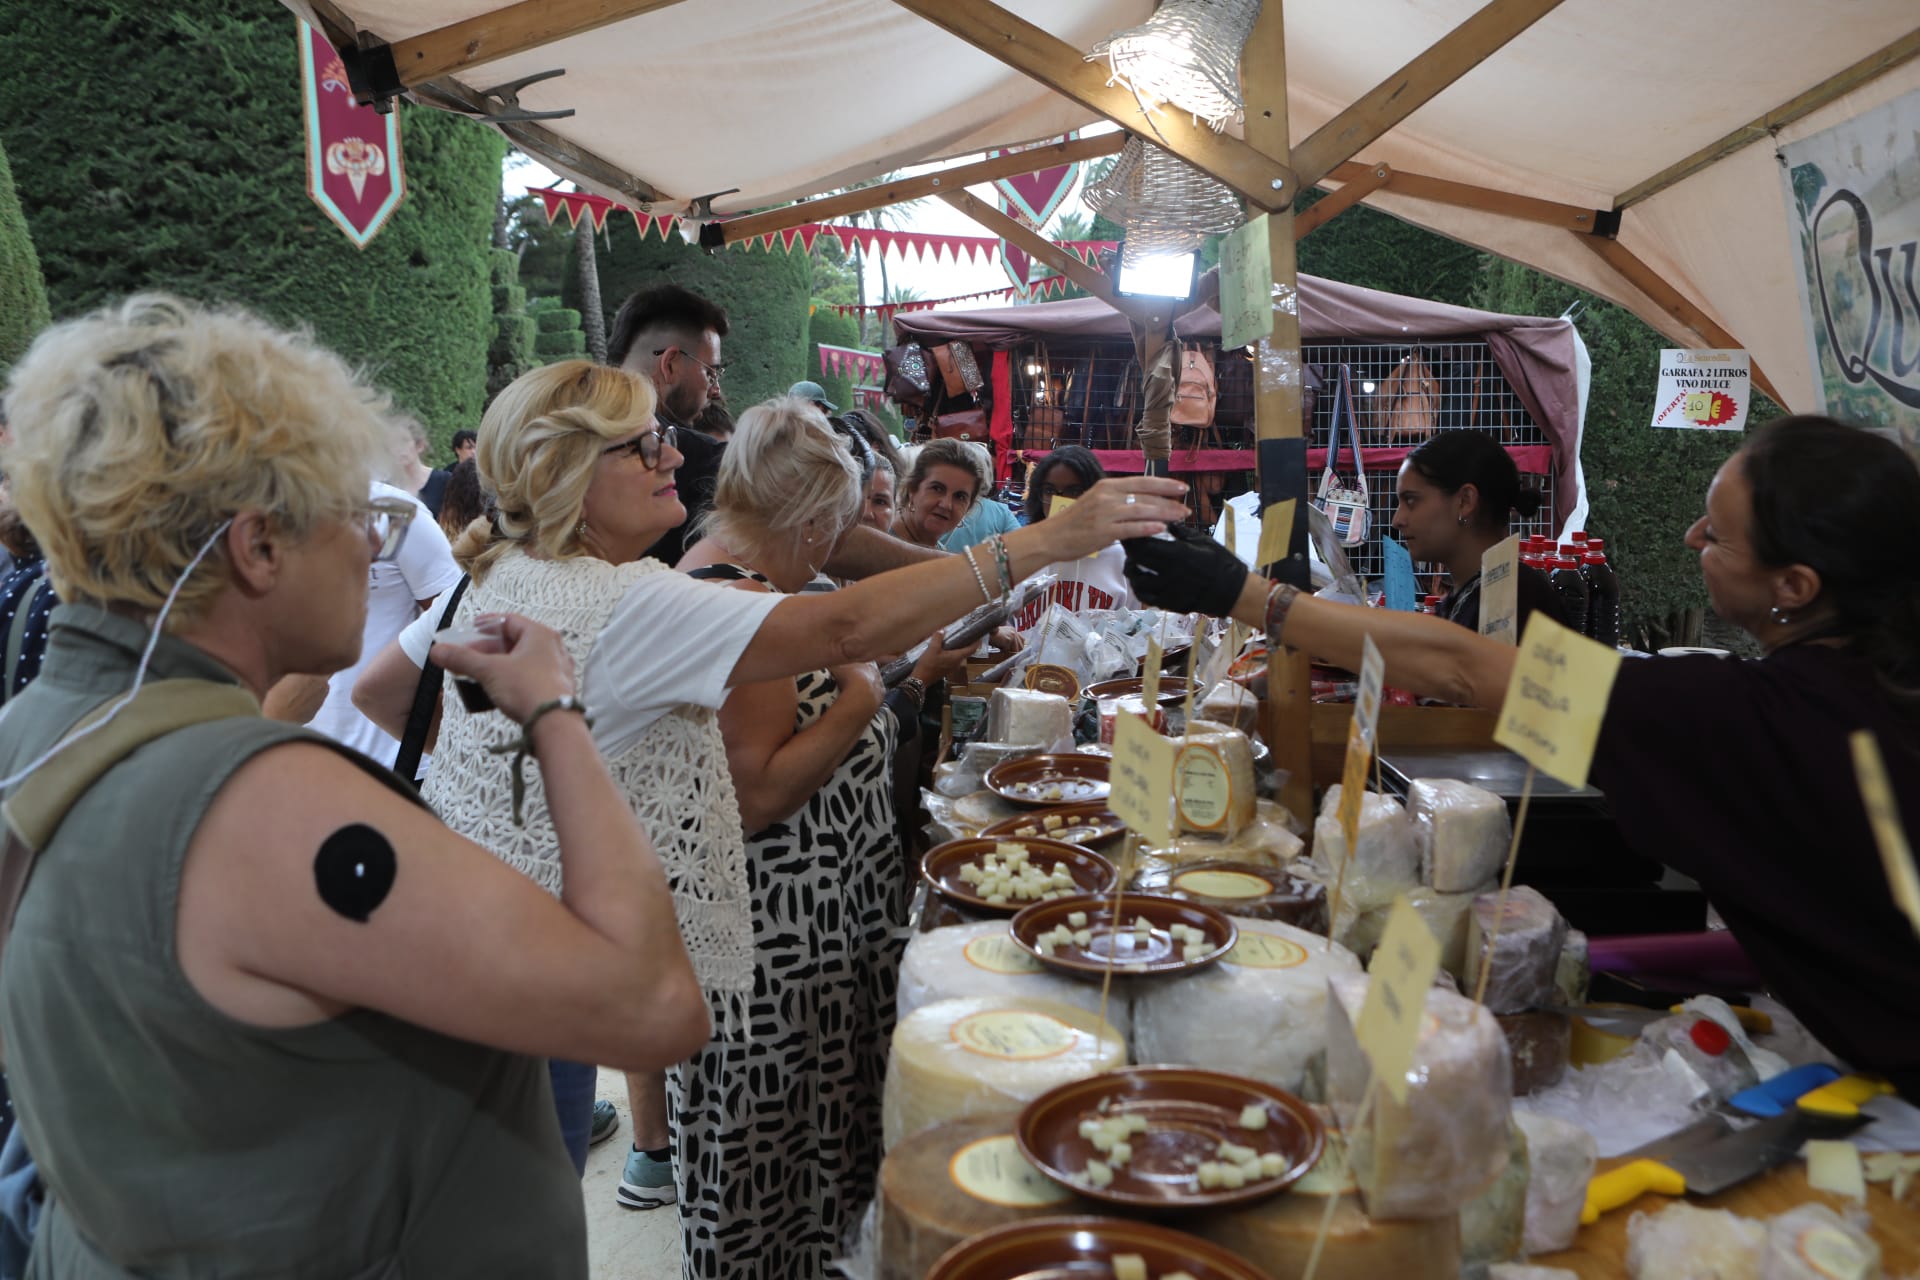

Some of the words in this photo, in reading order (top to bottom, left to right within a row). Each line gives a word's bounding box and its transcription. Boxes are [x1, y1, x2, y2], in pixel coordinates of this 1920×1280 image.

[1661, 368, 1704, 377] GARRAFA
[1706, 368, 1713, 377] 2
[1714, 368, 1748, 378] LITROS
[1676, 379, 1699, 388] VINO
[1700, 379, 1731, 389] DULCE
[1688, 400, 1704, 412] 10
